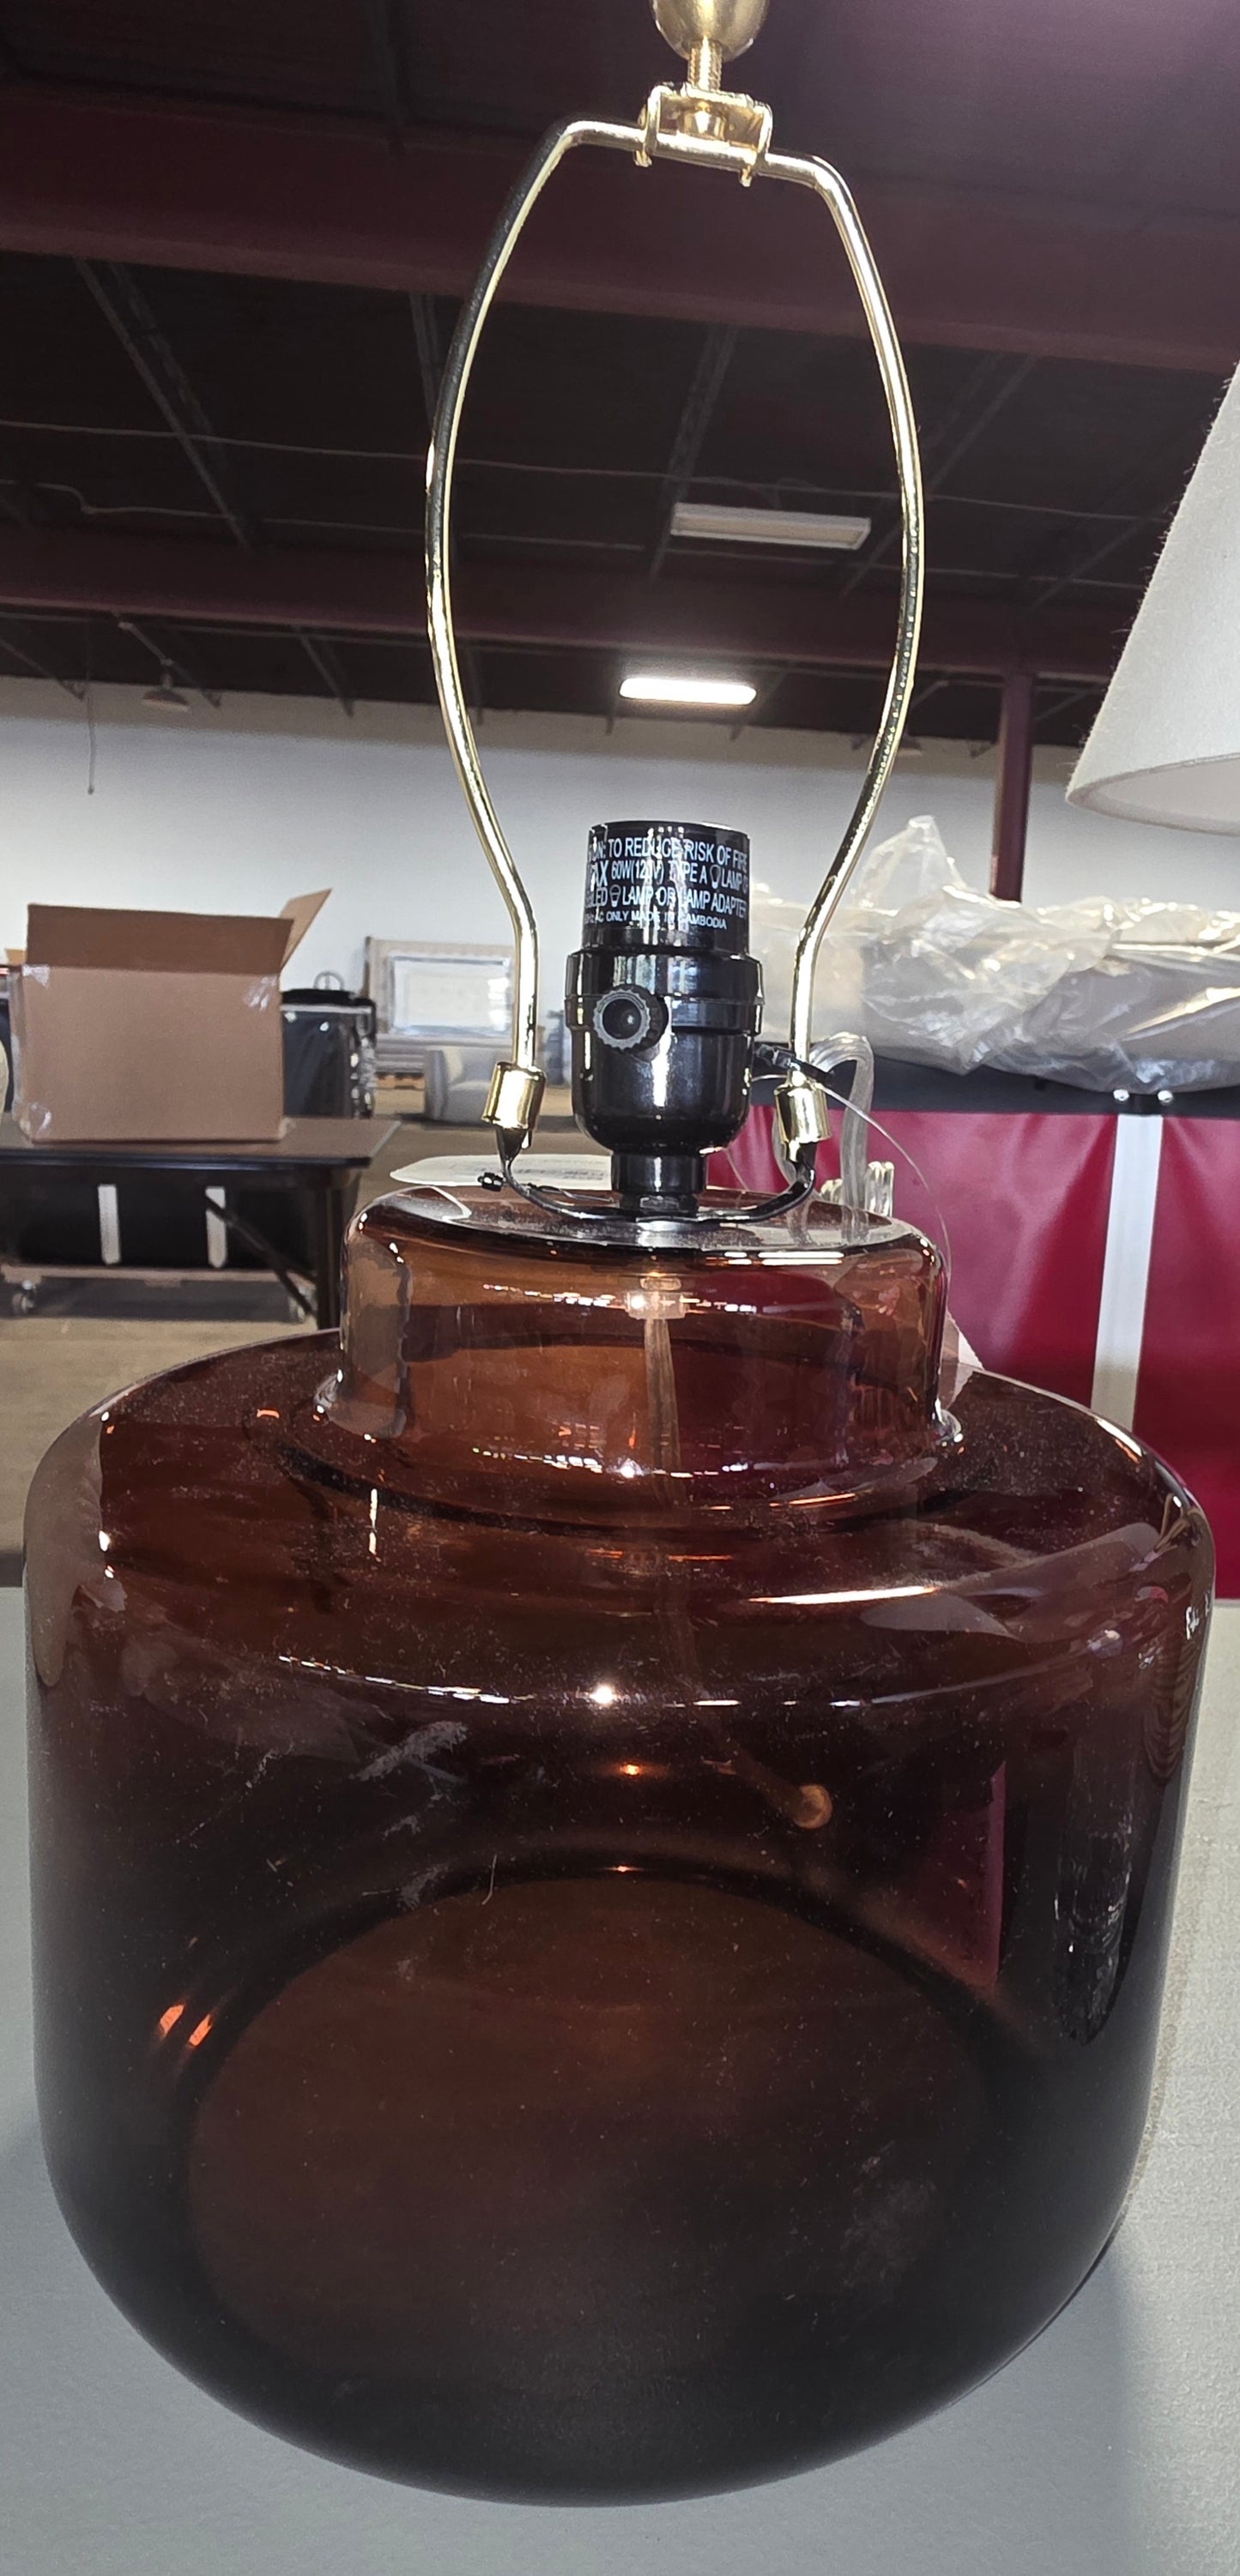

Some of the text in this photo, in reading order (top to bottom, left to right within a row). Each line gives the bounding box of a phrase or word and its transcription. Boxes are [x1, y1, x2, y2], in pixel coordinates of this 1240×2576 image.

[608, 837, 622, 858] TO
[624, 836, 682, 859] REDUCE
[684, 838, 715, 863] RISK
[717, 844, 732, 866] OF
[589, 860, 608, 887] AX
[699, 865, 708, 884] A
[721, 867, 742, 891] LAMP
[622, 885, 654, 906] LAMP
[606, 910, 629, 922] ONLY
